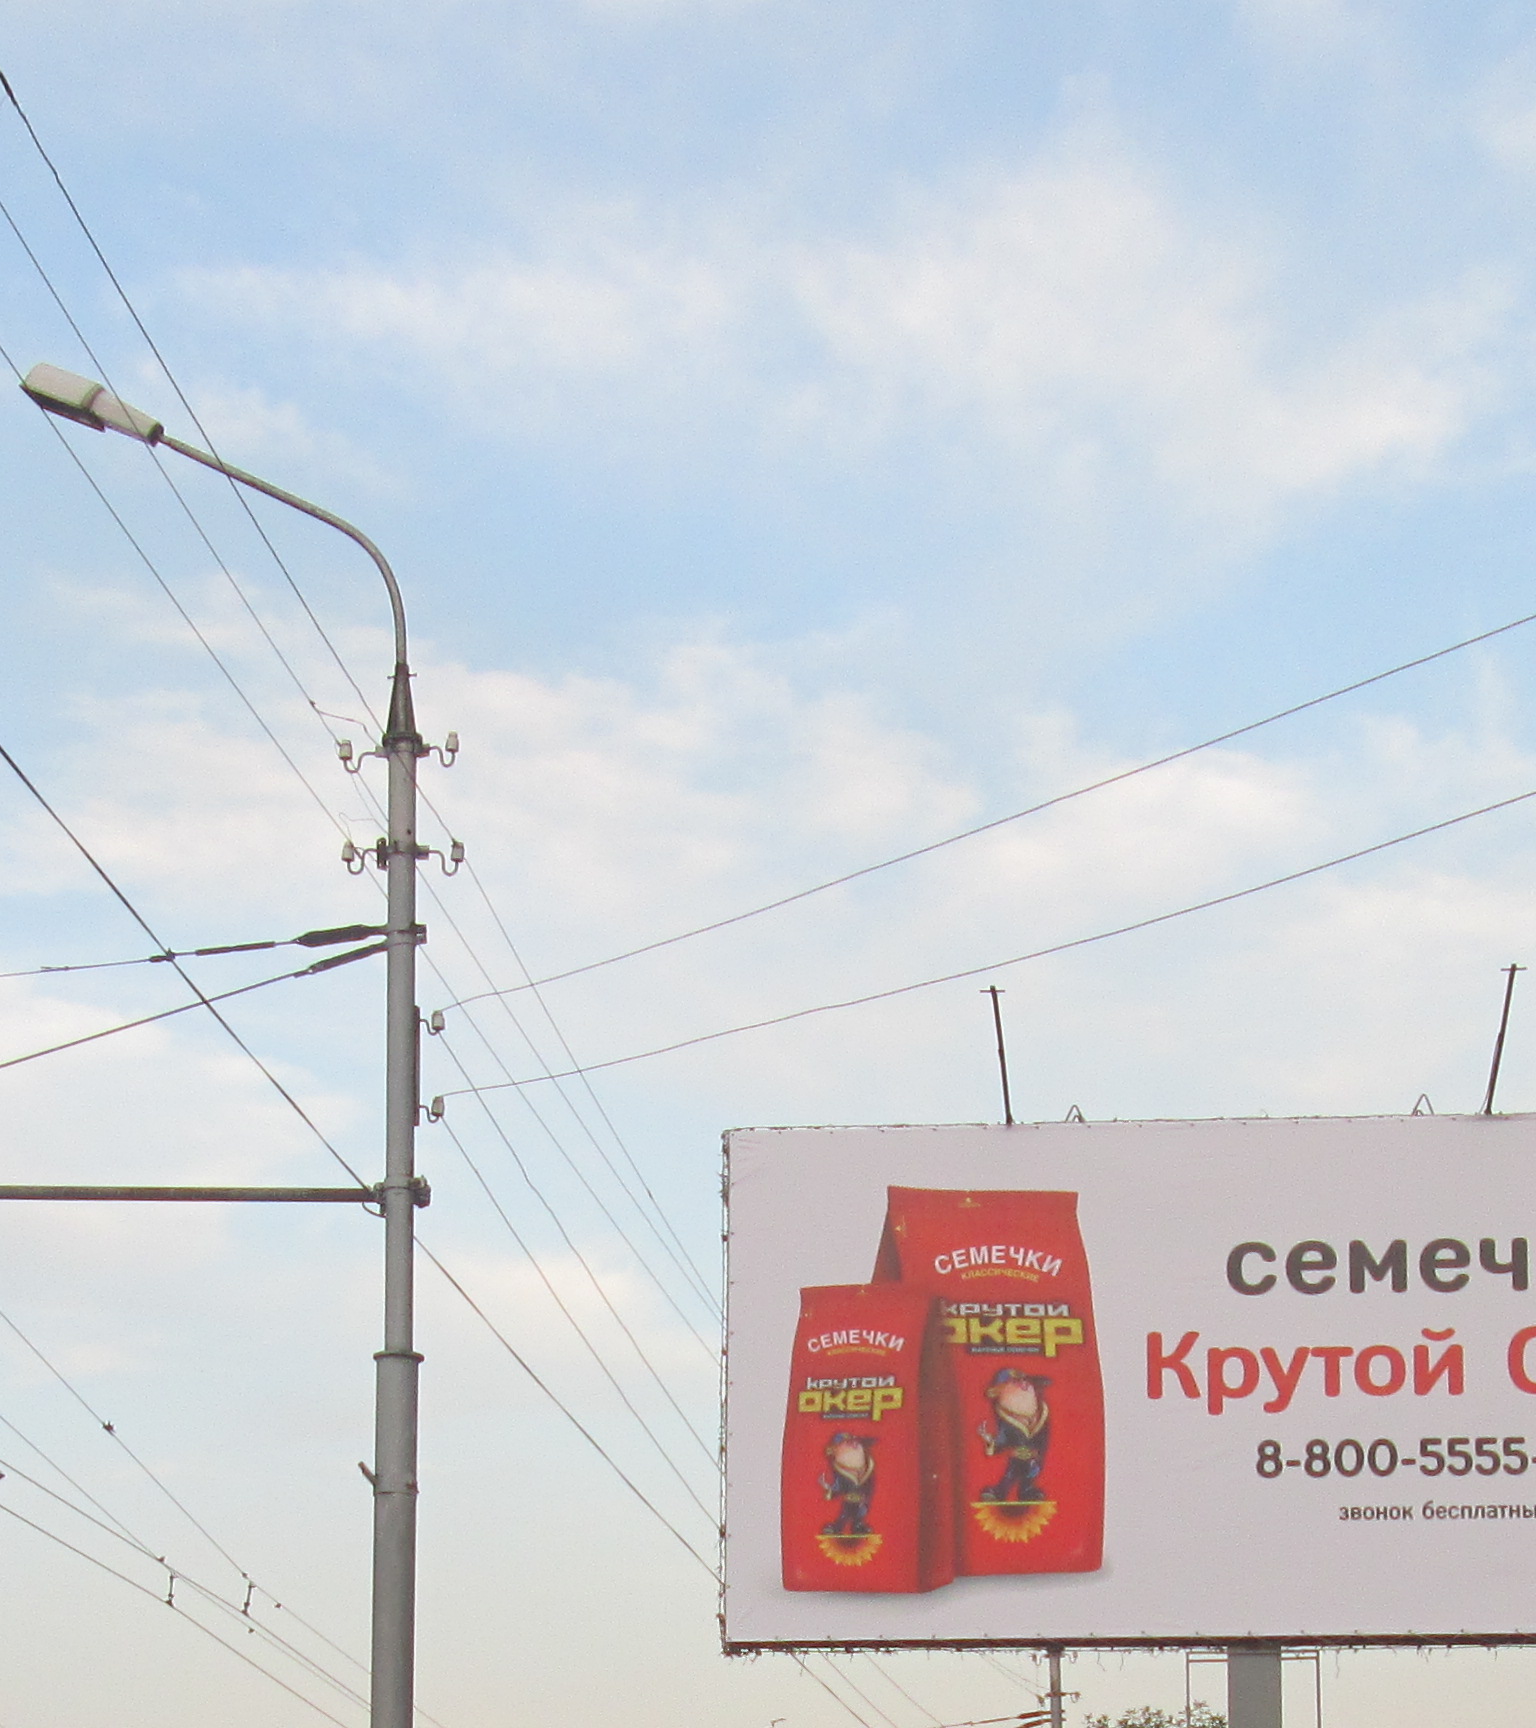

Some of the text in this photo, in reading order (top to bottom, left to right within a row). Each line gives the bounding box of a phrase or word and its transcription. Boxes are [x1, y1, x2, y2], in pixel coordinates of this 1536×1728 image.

[934, 1245, 1063, 1277] СЕМЕЧКИ
[961, 1267, 1040, 1283] КЛАССИЧЕСКИЕ
[807, 1329, 905, 1352] СЕМЕЧКИ
[1146, 1327, 1465, 1416] Крутой
[1338, 1503, 1415, 1521] звонок
